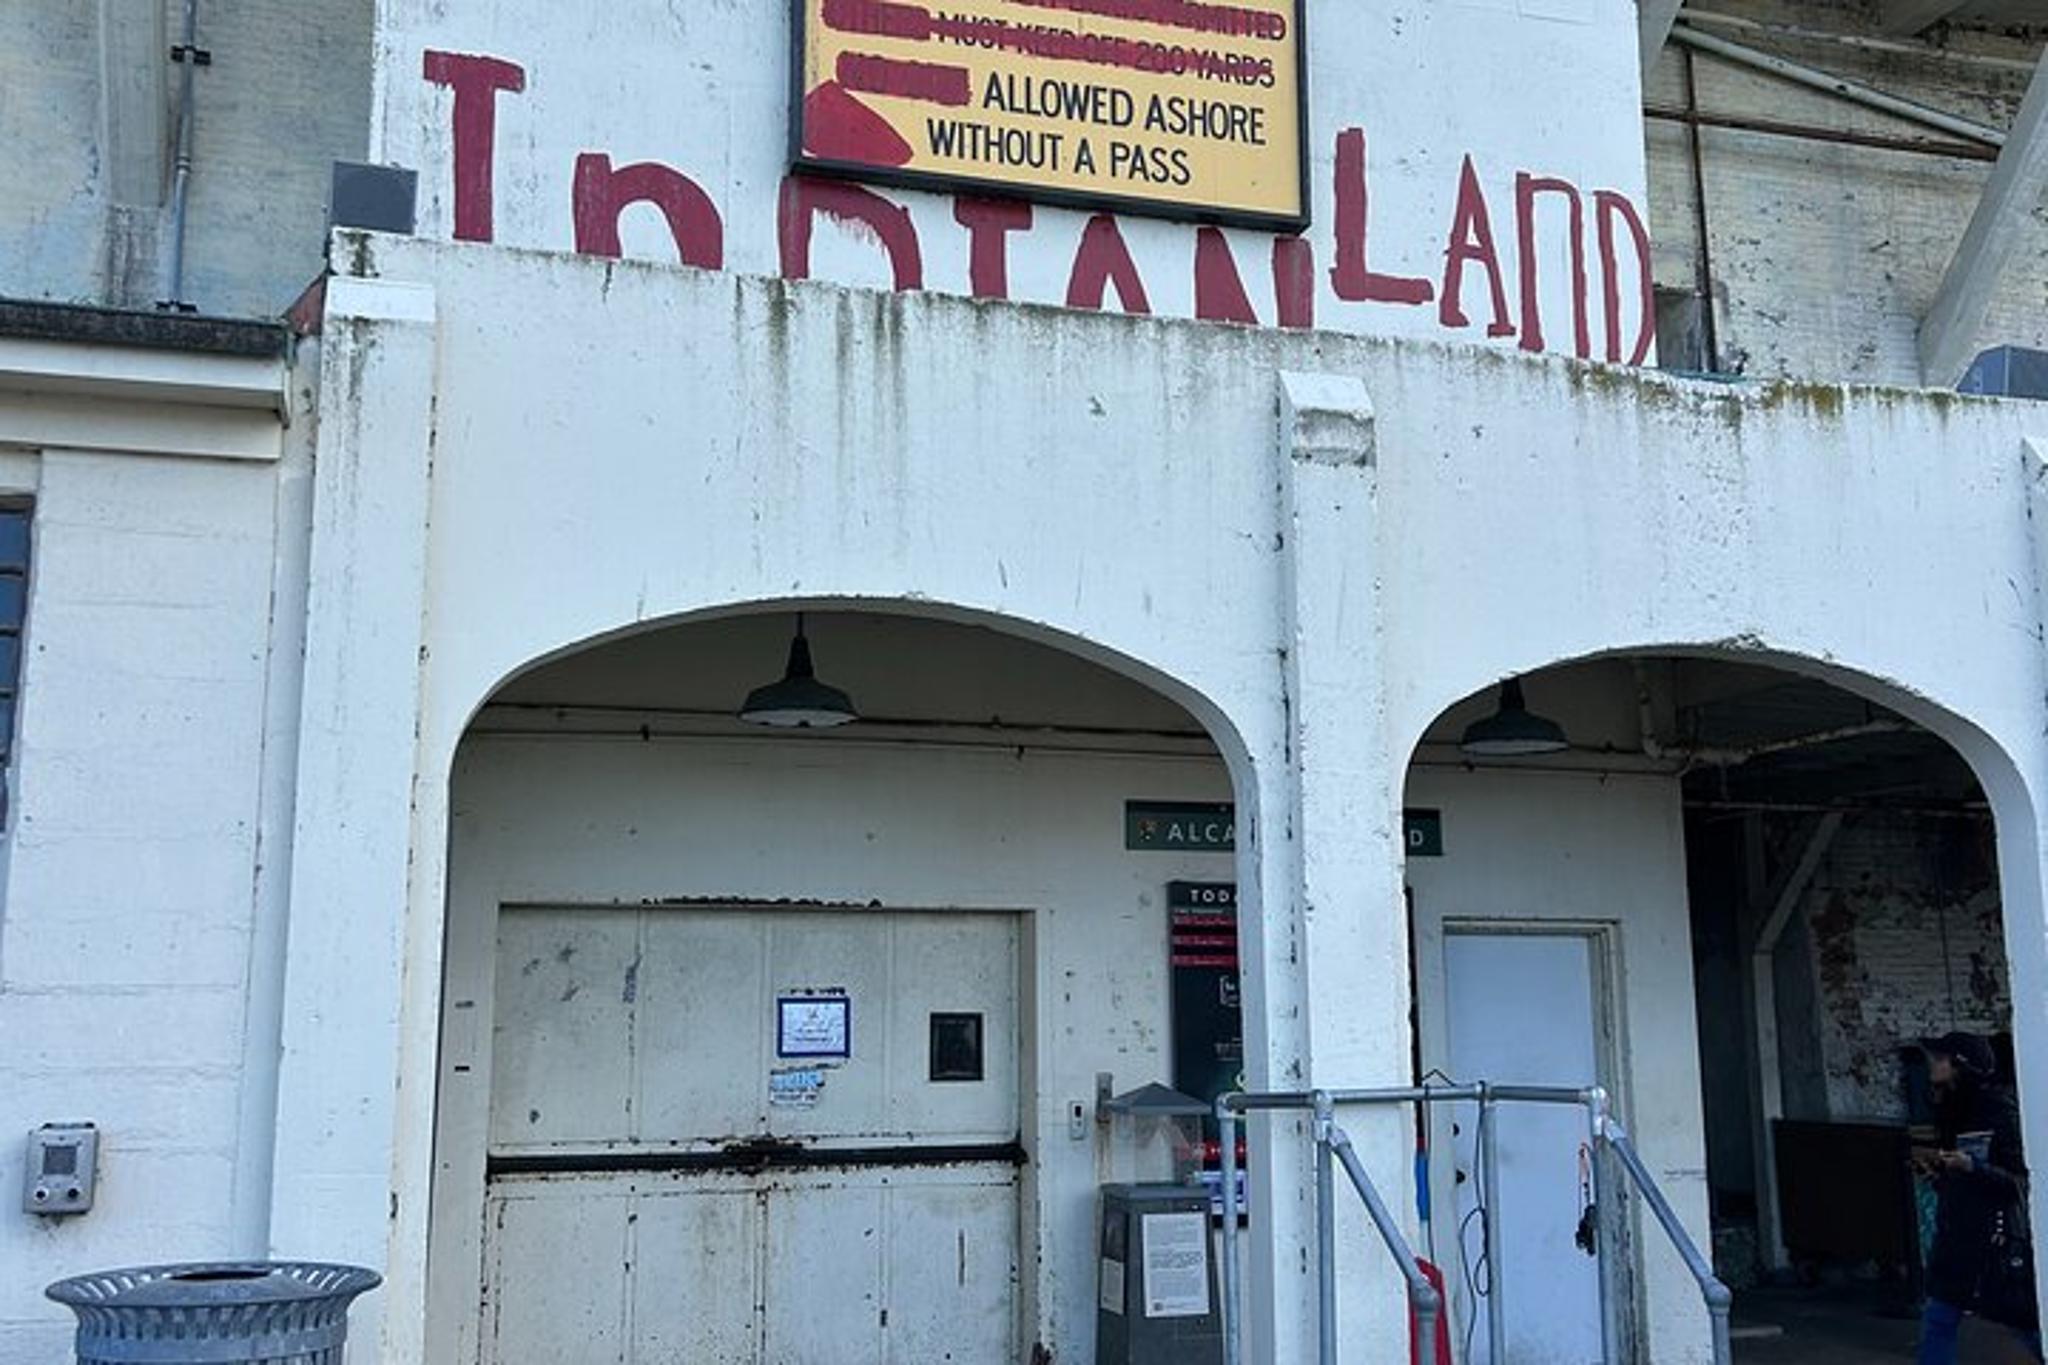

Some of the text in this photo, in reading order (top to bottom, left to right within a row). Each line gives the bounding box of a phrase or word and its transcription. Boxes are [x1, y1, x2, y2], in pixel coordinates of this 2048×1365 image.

[982, 71, 1266, 145] ALLOWED ASHORE
[927, 117, 1190, 185] WITHOUT A PASS
[1168, 822, 1236, 843] ALCA
[1190, 888, 1238, 903] TOD
